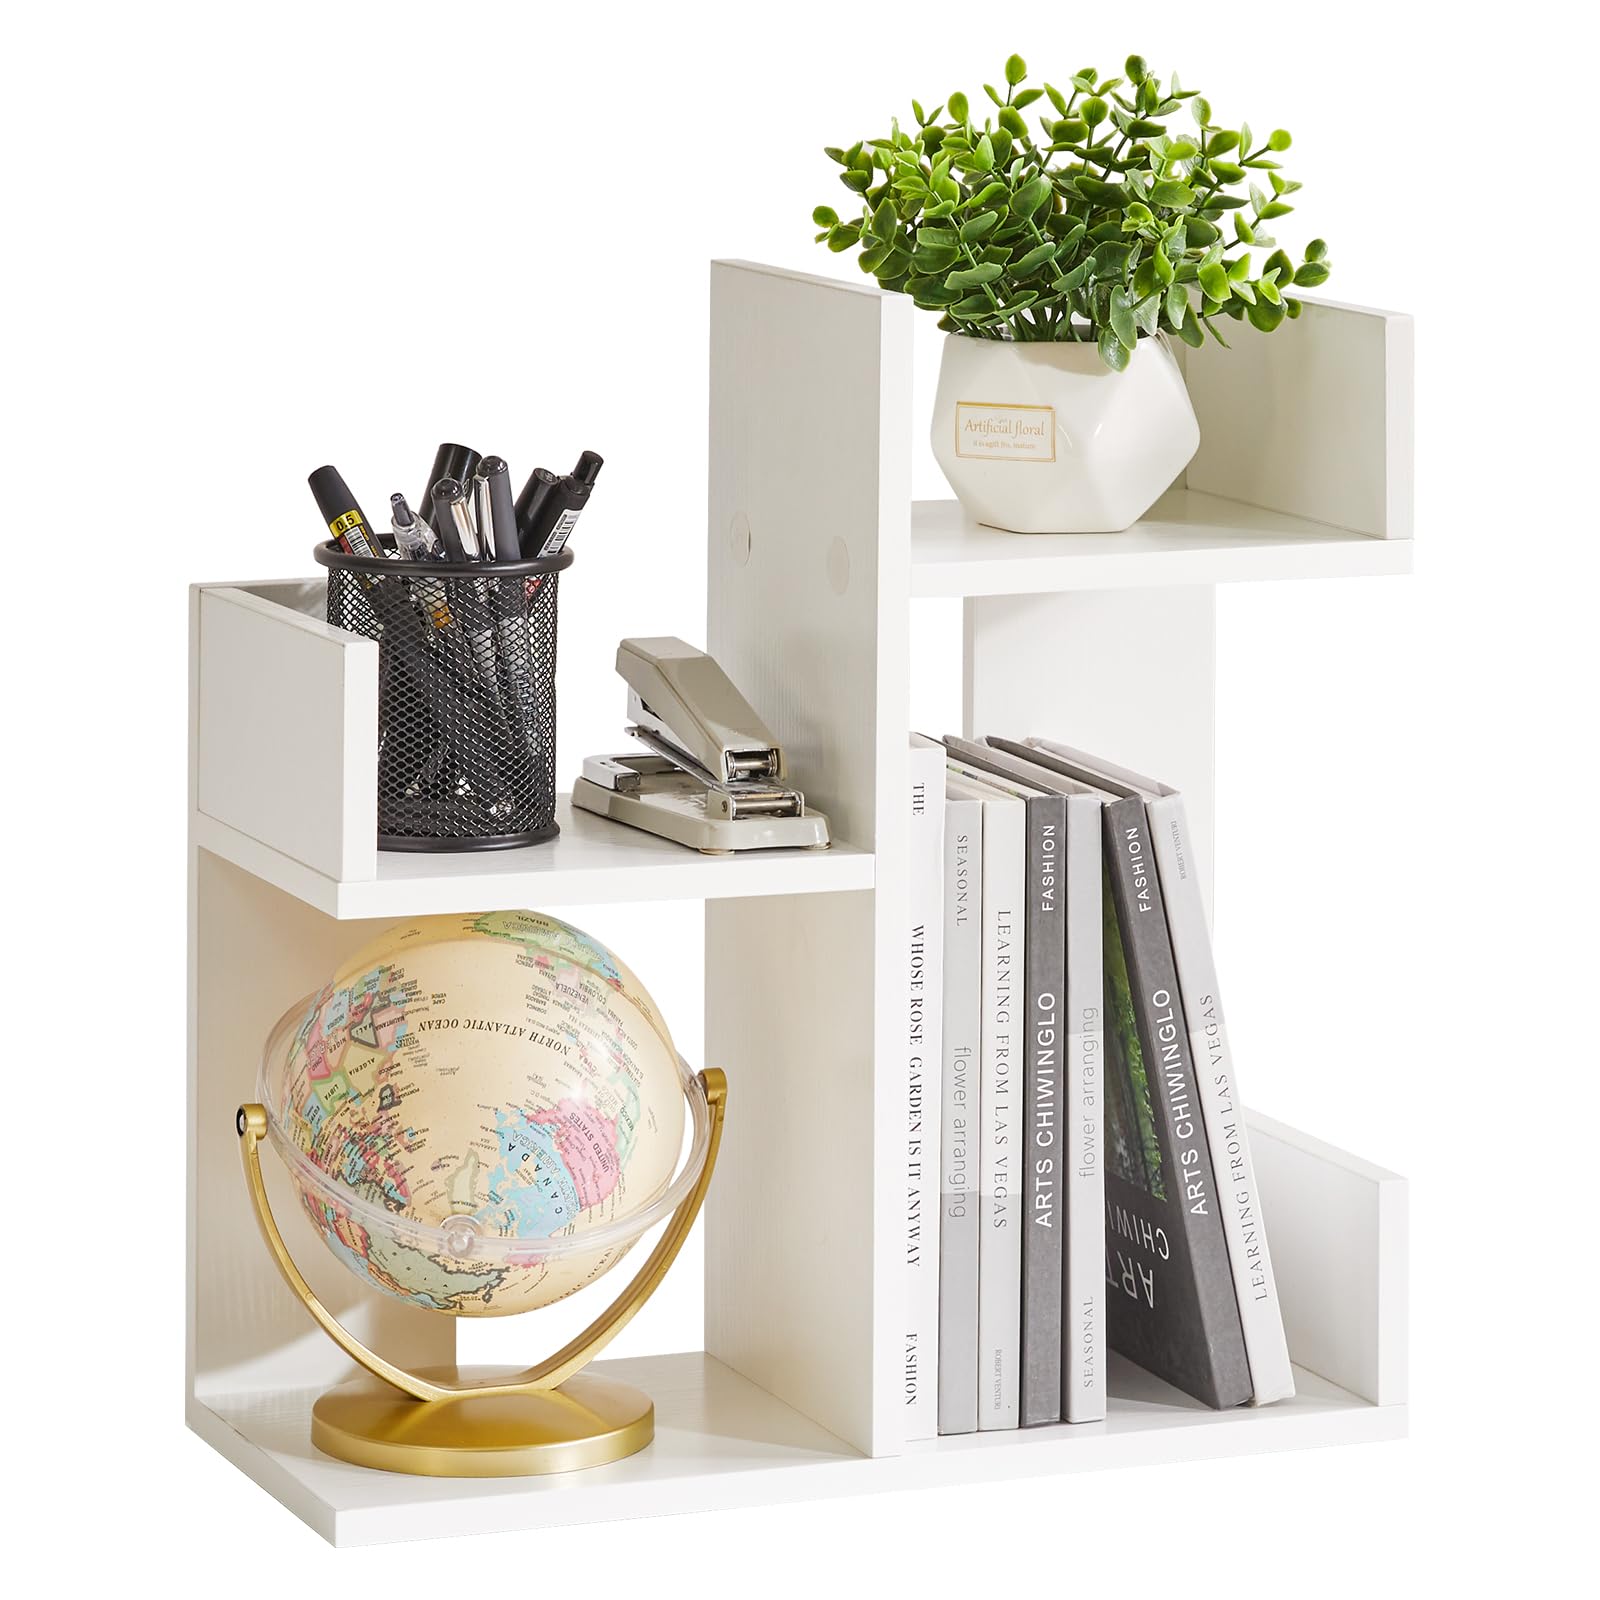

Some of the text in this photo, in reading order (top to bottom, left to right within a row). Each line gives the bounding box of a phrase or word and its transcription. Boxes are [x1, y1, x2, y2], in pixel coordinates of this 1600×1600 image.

[965, 418, 1044, 439] Artificial floral
[336, 514, 355, 531] 0.5
[913, 783, 924, 815] THE
[957, 835, 968, 926] SEASONAL
[1042, 825, 1055, 912] FASHION
[1126, 827, 1151, 912] FASHION
[555, 982, 589, 1005] VENEZUELA
[579, 983, 606, 1005] COLOMBIA
[329, 1037, 347, 1053] NIGER
[375, 1016, 405, 1032] MAURITANIA
[418, 1019, 459, 1032] OCEAN
[463, 1020, 527, 1037] ATLANTIC
[529, 1031, 571, 1056] NORTH
[349, 1057, 375, 1076] ALGERIA
[994, 910, 1011, 1228] LEARNING FROM LAS VEGAS
[323, 1084, 339, 1101] LIBYA
[620, 1105, 634, 1131] MEXICO
[906, 925, 924, 1267] WHOSE ROSE GARDEN IS IT ANYWAY
[1035, 993, 1055, 1227] ARTS CHIWINGLO
[1079, 1008, 1099, 1177] flower arranging
[1152, 989, 1209, 1215] ARTS CHIWINGLO
[380, 1113, 400, 1126] FRANCE
[569, 1112, 610, 1173] UNITED STATES
[949, 1047, 971, 1218] flower arranging
[512, 1130, 560, 1174] AMERICA
[1200, 995, 1268, 1301] LEARNING FROM LAS VEGAS
[508, 1143, 563, 1215] CANADA
[1105, 1250, 1154, 1309] ART
[1084, 1296, 1094, 1389] SEASONAL
[905, 1332, 918, 1406] FASHION
